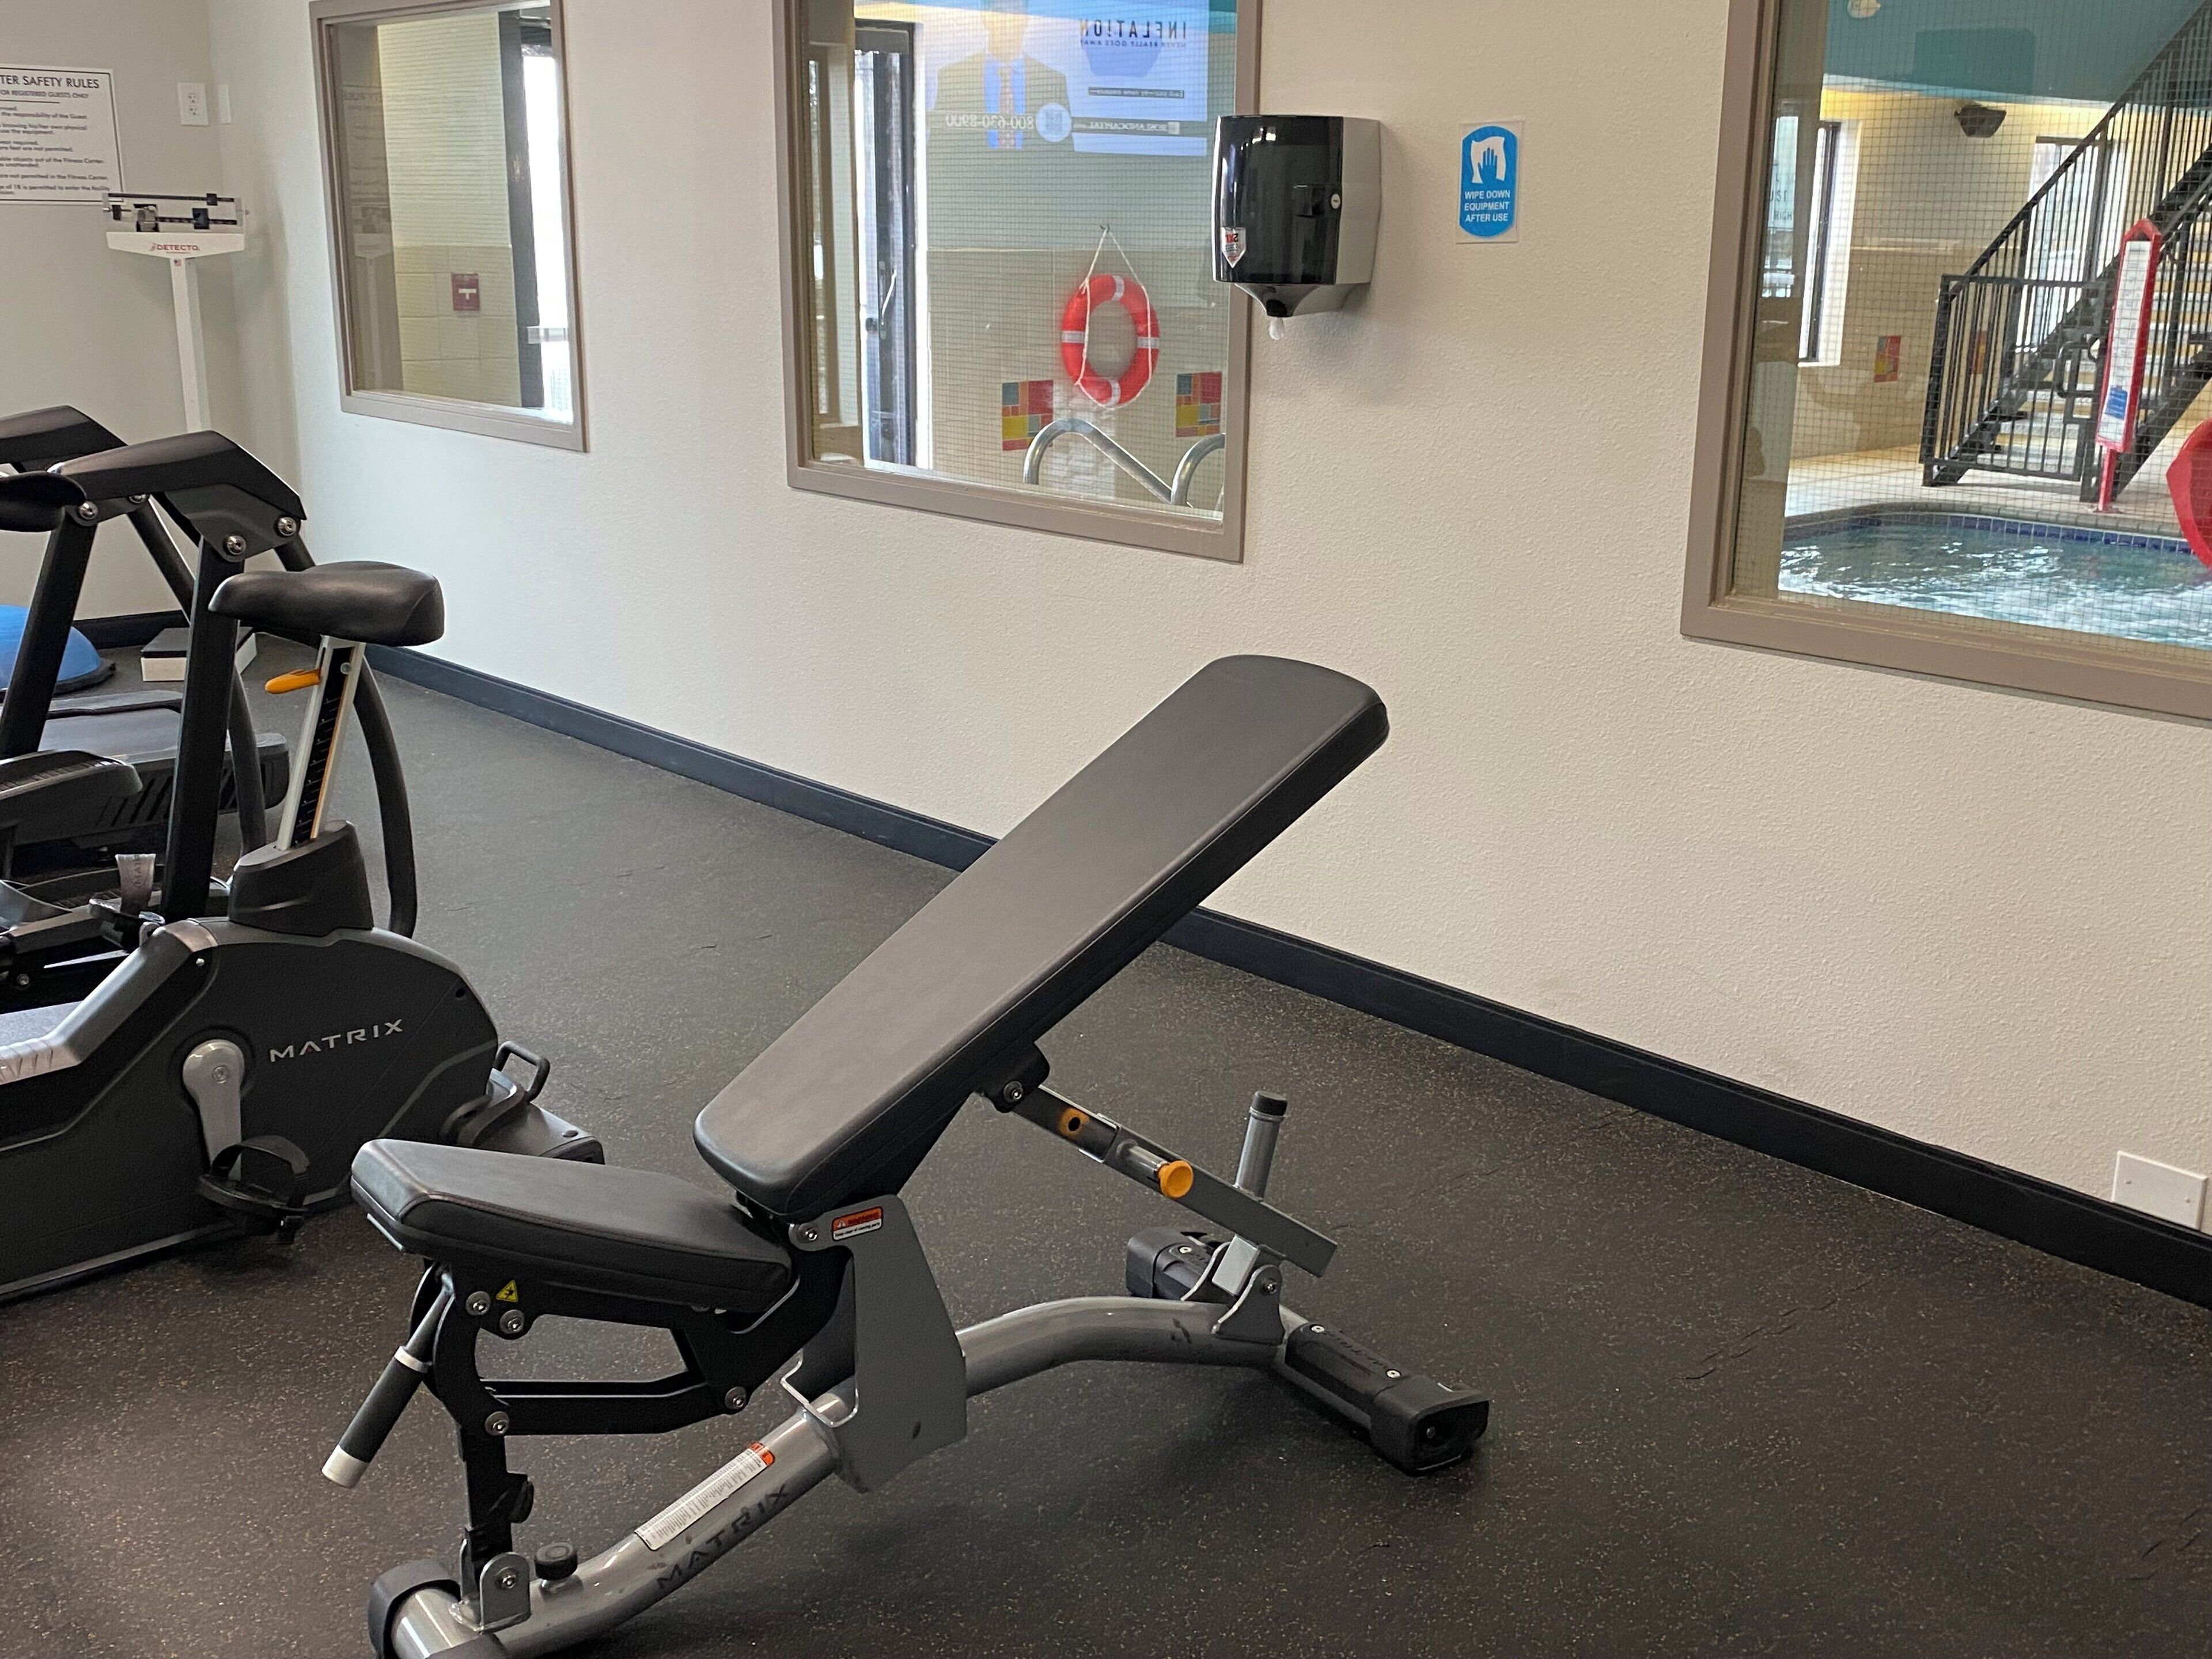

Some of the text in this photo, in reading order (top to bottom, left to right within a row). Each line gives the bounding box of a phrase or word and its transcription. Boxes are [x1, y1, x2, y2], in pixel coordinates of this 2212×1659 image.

[24, 76, 62, 86] SAFETY
[66, 78, 100, 88] RULES
[1465, 190, 1510, 199] WIPE DOWN
[1464, 202, 1509, 211] EQUIPMENT
[1465, 213, 1508, 222] AFTER USE
[270, 1019, 403, 1062] MATRIX
[657, 1484, 789, 1587] MATRIX
